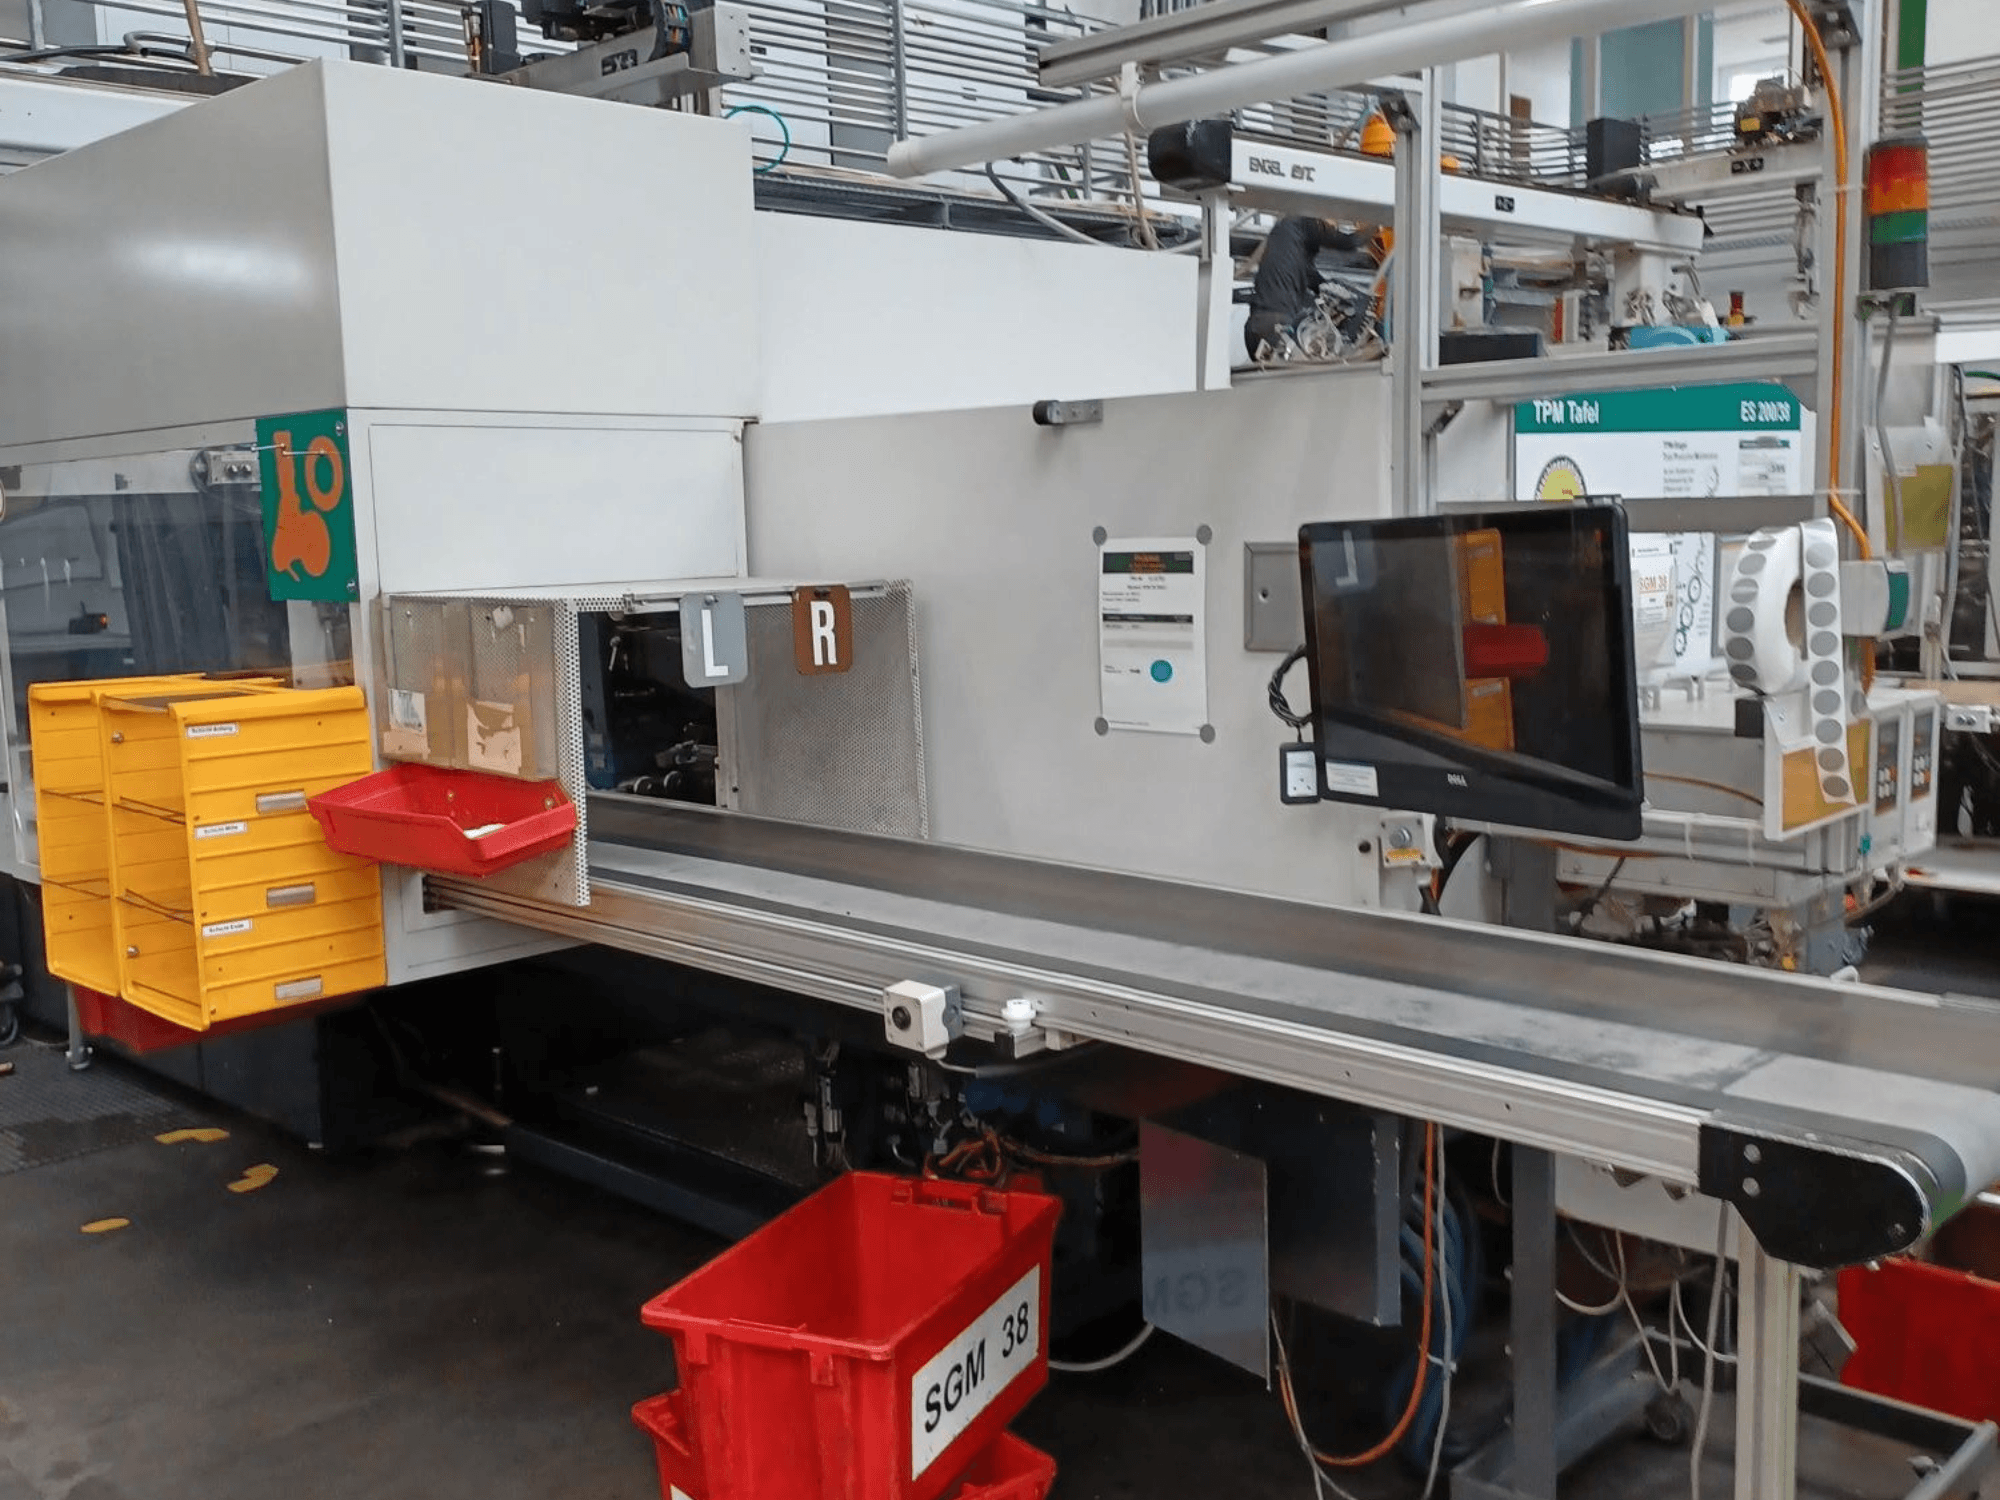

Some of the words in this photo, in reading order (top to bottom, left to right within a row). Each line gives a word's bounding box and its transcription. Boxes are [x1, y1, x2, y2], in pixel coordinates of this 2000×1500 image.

[1249, 156, 1285, 177] ENGEL
[1533, 399, 1564, 424] TPM
[1567, 399, 1599, 424] Tafel
[1740, 400, 1757, 422] ES
[701, 609, 729, 678] L
[810, 600, 838, 666] R
[925, 1337, 986, 1434] SGM
[1002, 1301, 1029, 1359] 38
